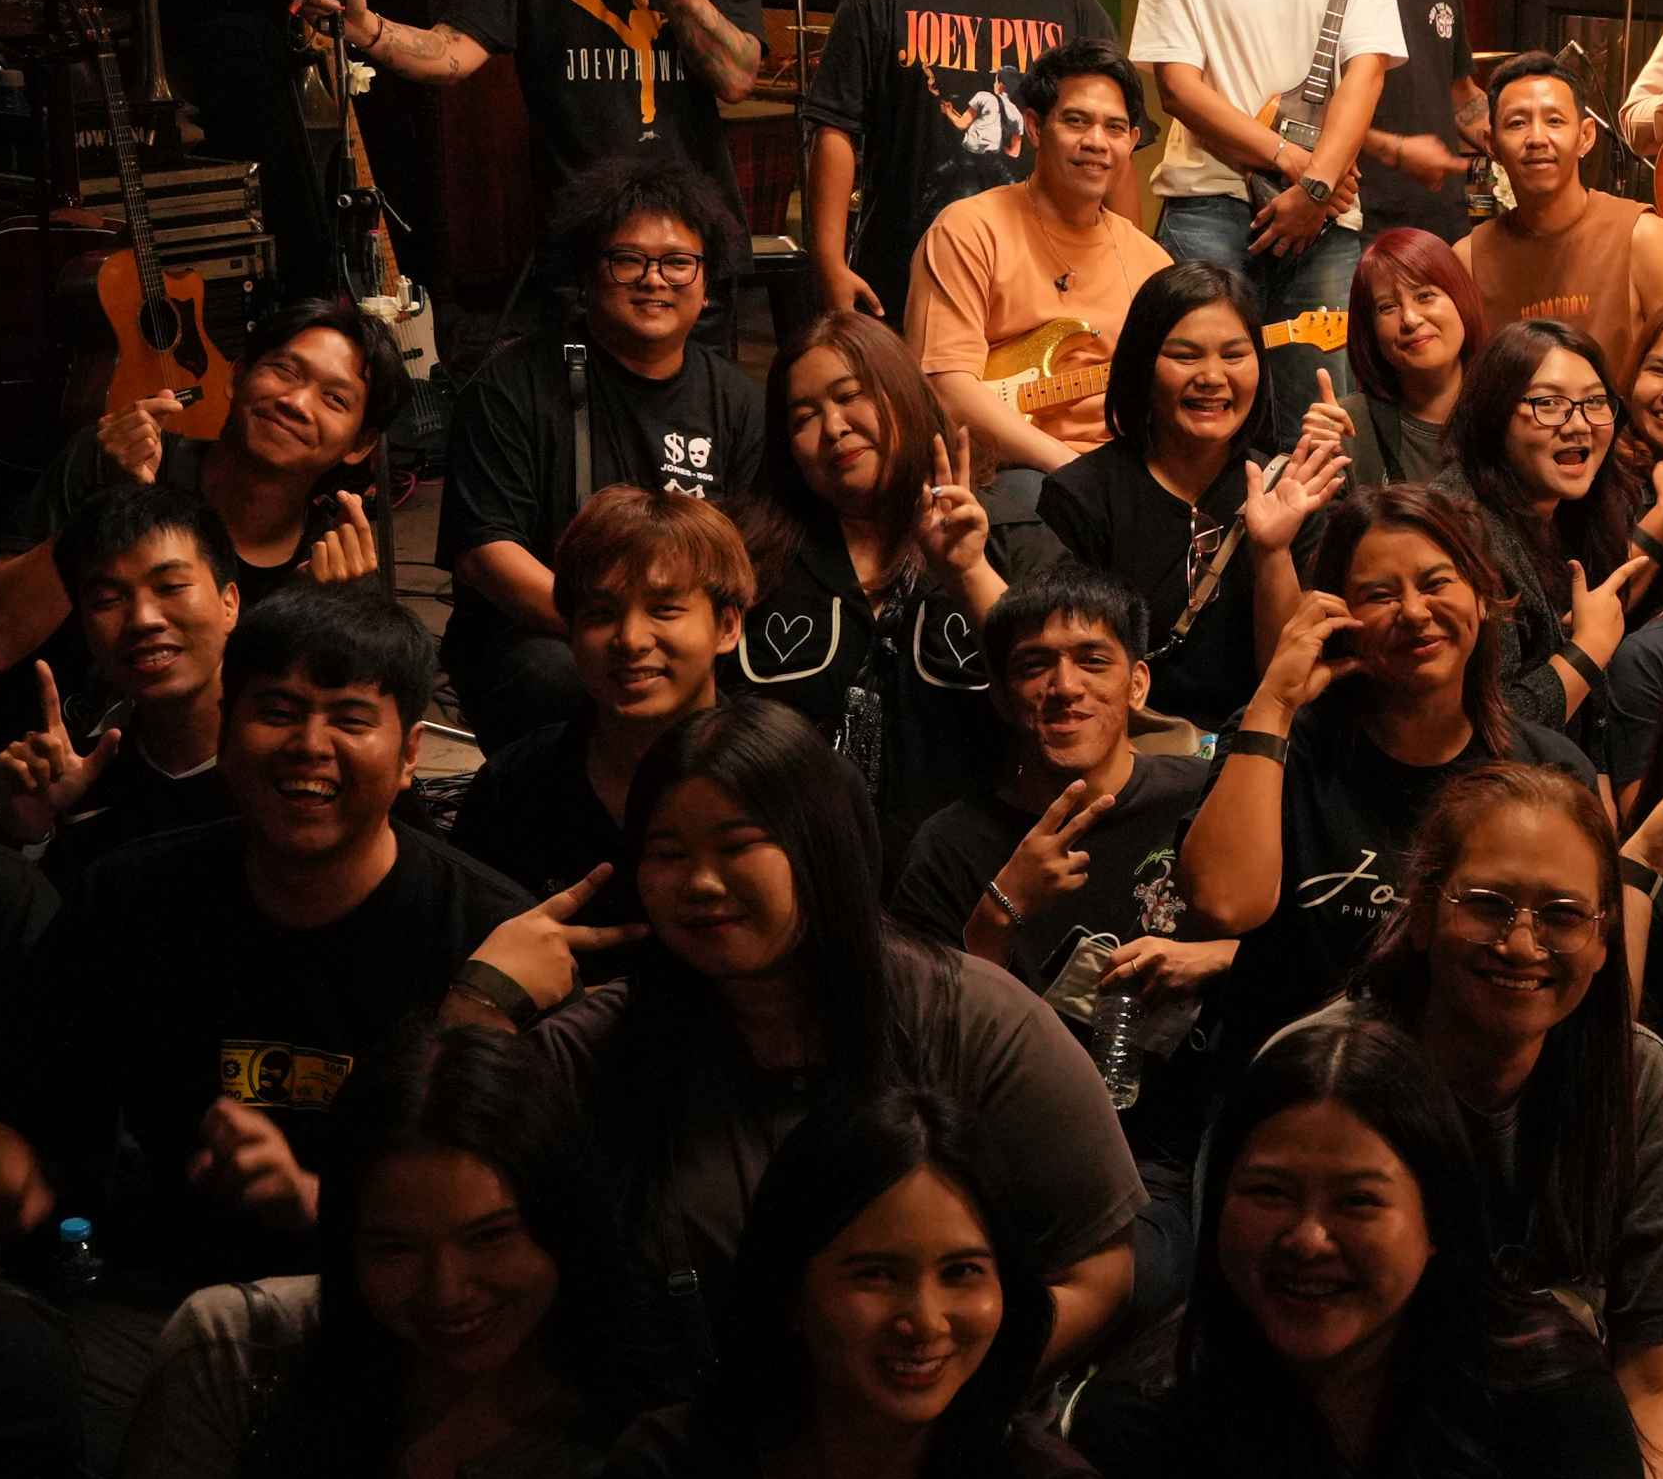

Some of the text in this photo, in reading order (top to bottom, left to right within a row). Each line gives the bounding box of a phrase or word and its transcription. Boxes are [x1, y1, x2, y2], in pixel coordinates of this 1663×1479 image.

[898, 9, 1064, 76] JOEY PWS
[1296, 848, 1409, 909] Jo
